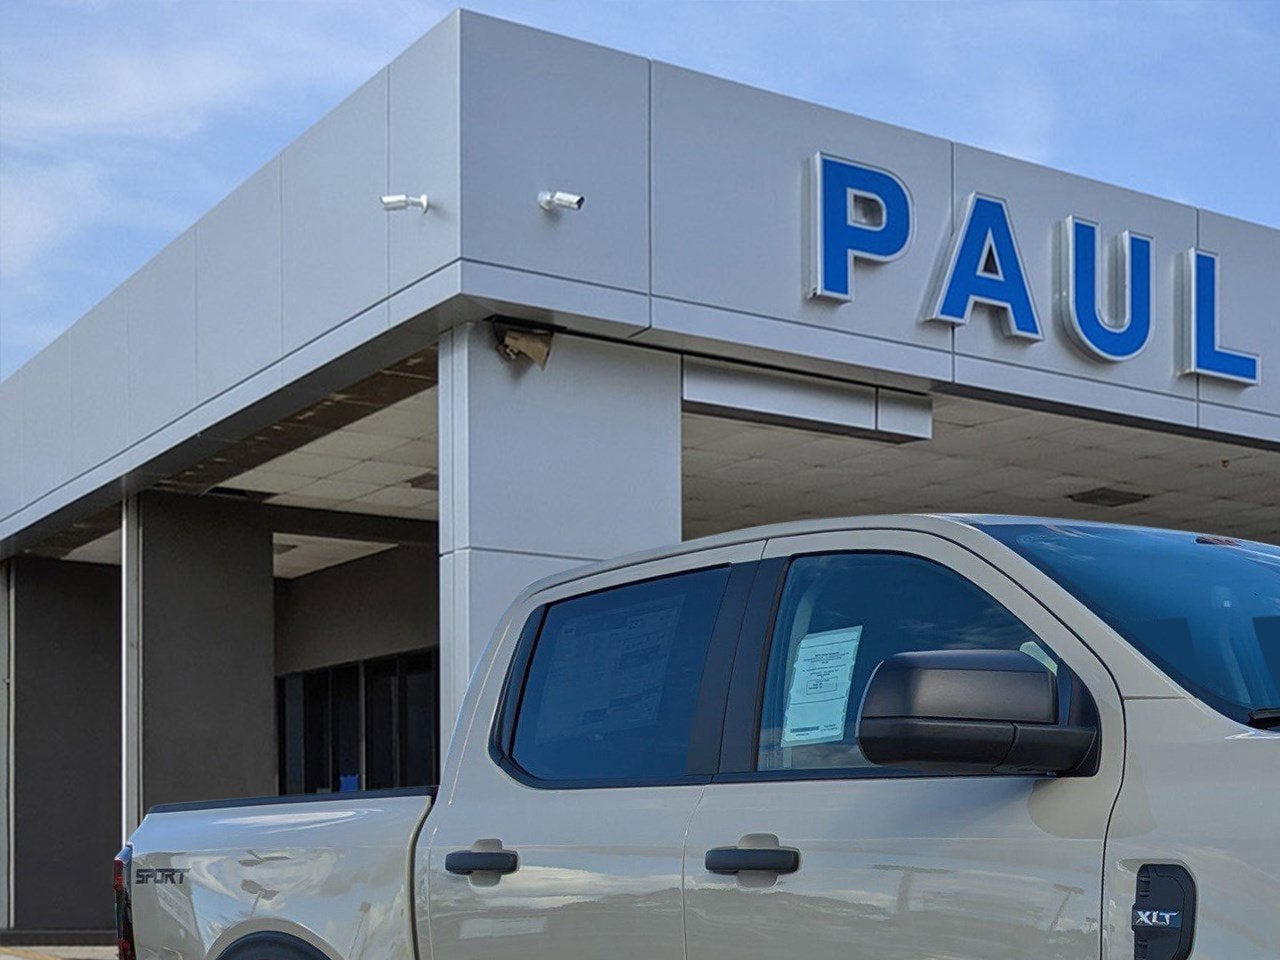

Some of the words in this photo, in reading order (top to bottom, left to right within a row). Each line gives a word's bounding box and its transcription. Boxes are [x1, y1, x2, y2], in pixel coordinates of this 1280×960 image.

[814, 153, 1261, 385] PAUL
[135, 868, 191, 885] SPORT
[1135, 910, 1179, 926] XLT
